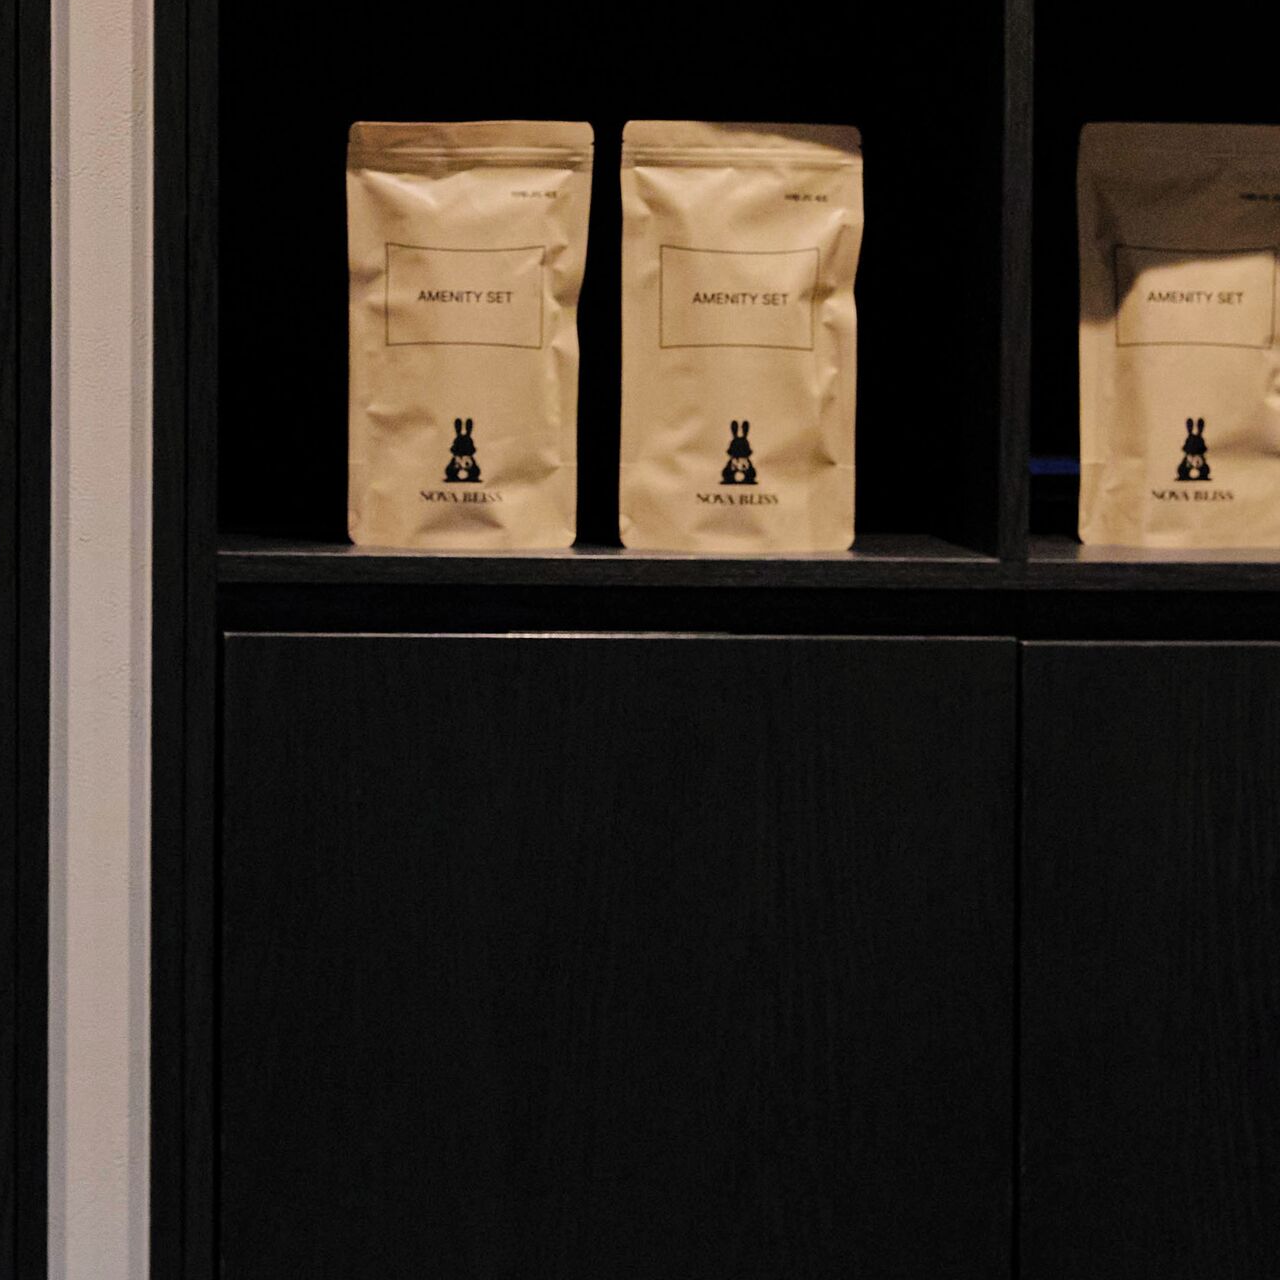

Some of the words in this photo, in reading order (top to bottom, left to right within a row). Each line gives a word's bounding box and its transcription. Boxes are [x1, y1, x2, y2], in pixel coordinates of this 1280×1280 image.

[417, 290, 483, 303] AMENITY
[486, 290, 513, 303] SET
[692, 292, 759, 305] AMENITY
[762, 292, 789, 305] SET
[1147, 292, 1214, 304] AMENITY
[1217, 292, 1244, 304] SET
[696, 493, 735, 504] NOVA
[740, 493, 779, 505] BLISS
